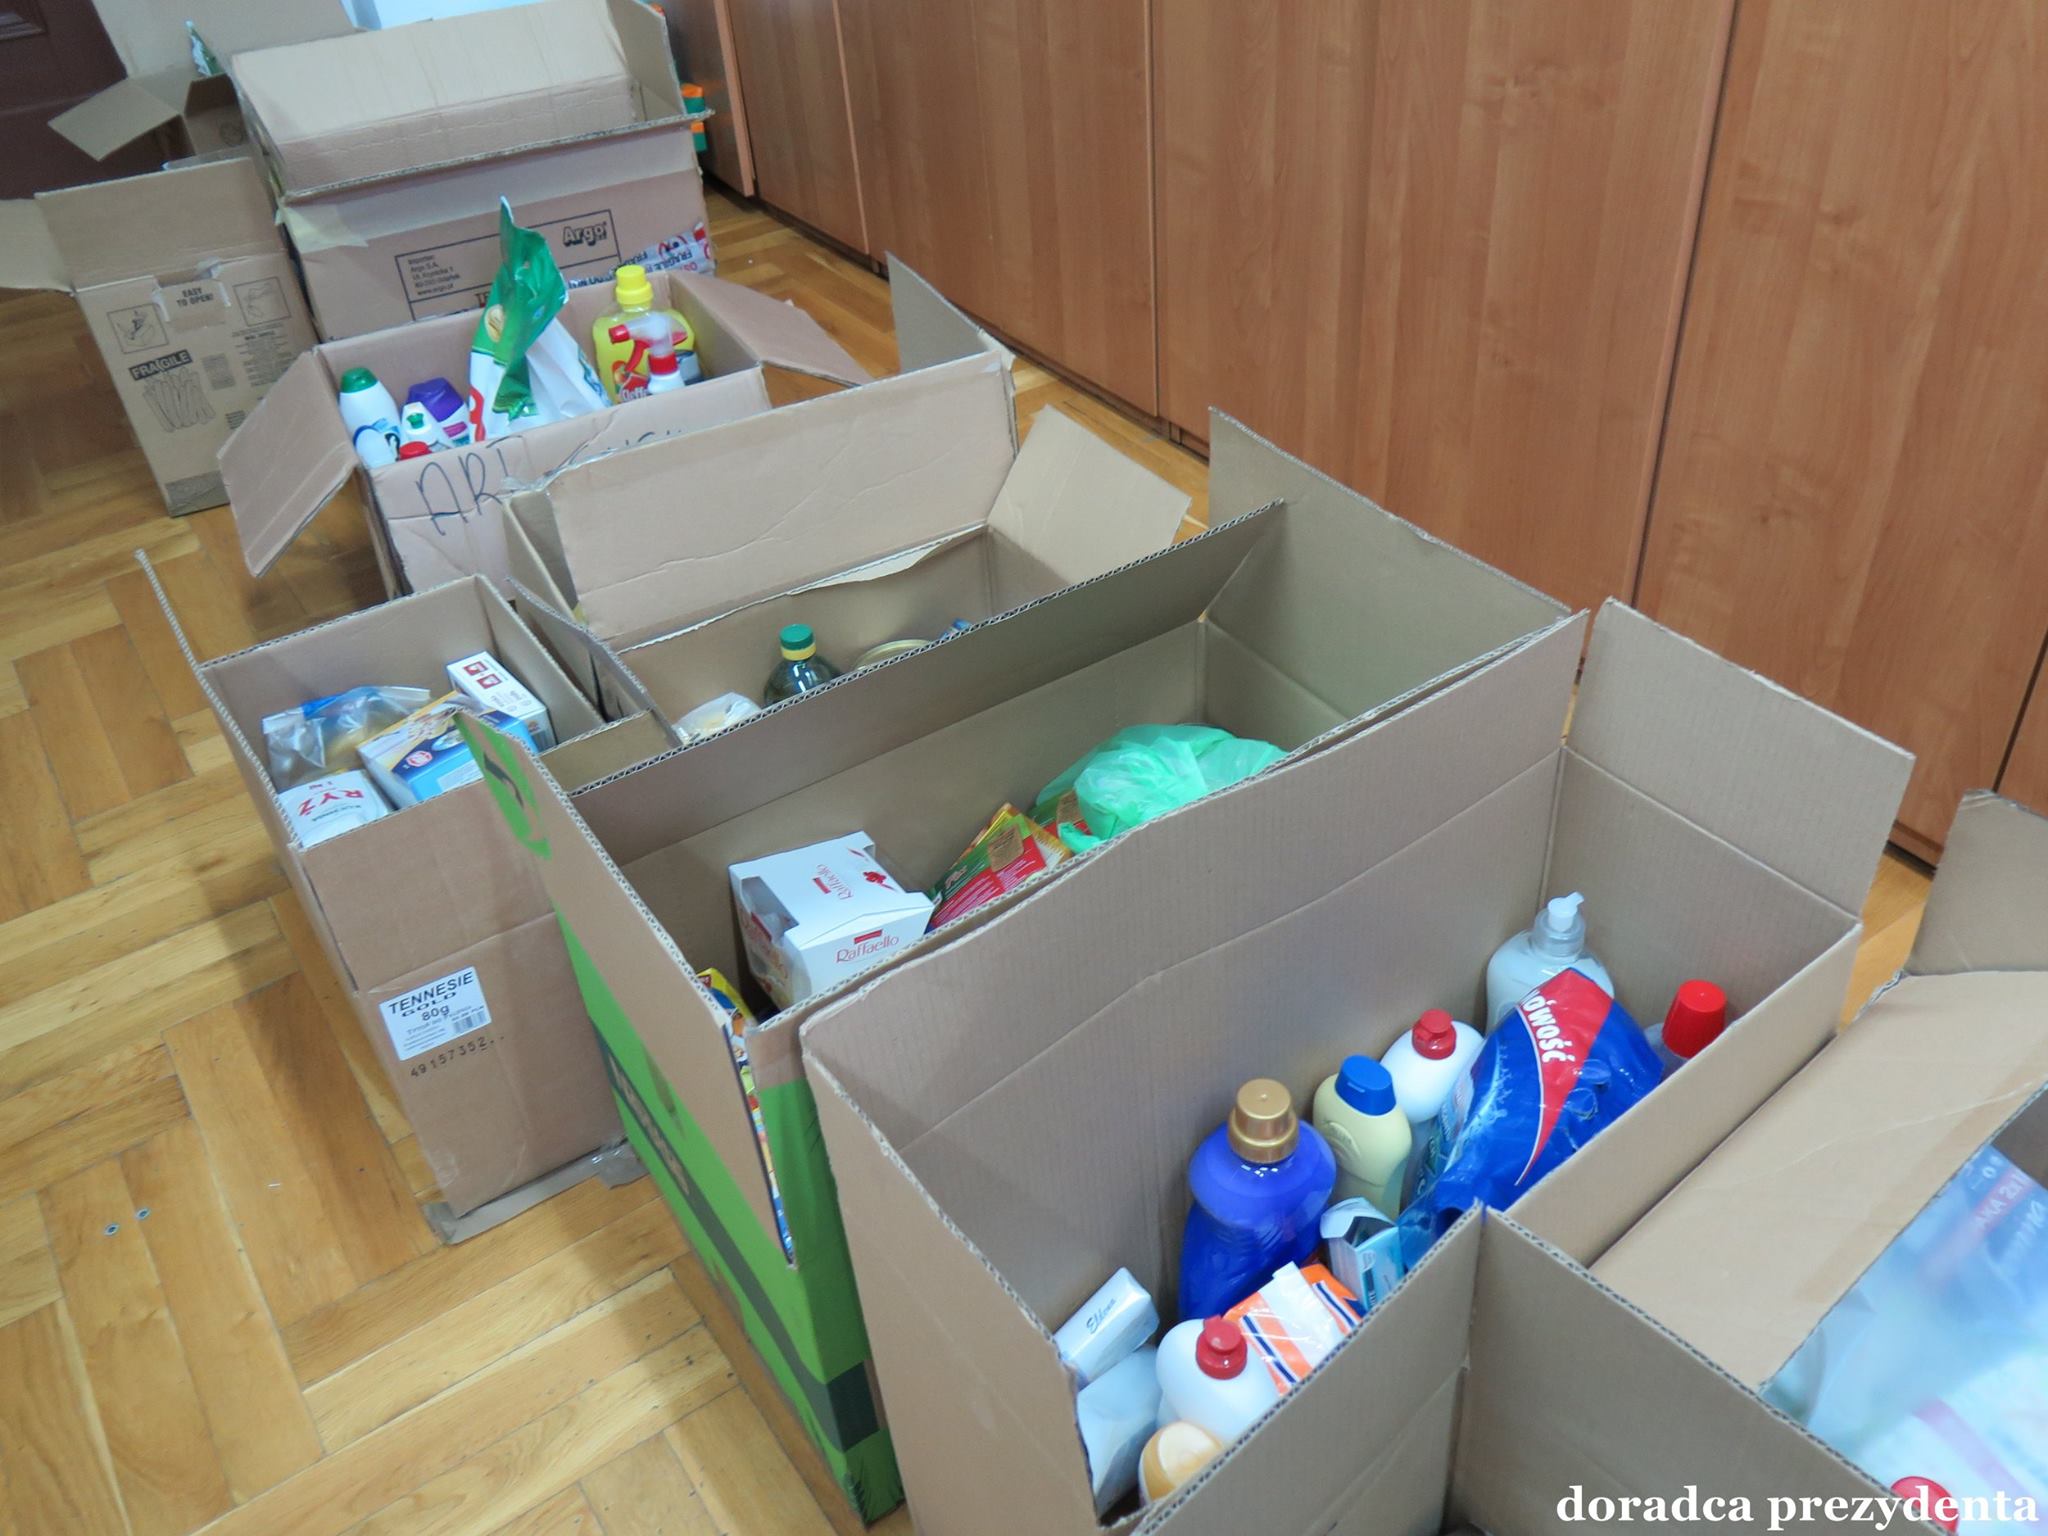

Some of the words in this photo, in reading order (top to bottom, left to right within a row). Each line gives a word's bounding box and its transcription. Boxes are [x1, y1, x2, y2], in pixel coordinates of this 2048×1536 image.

[563, 225, 607, 247] Argo
[176, 299, 189, 308] TO
[182, 287, 203, 298] EASY
[132, 350, 190, 379] FRAGILE
[835, 935, 900, 964] Raffaello
[388, 971, 474, 1014] TENNESIE
[401, 991, 457, 1017] GOLD
[421, 1005, 450, 1021] 80g
